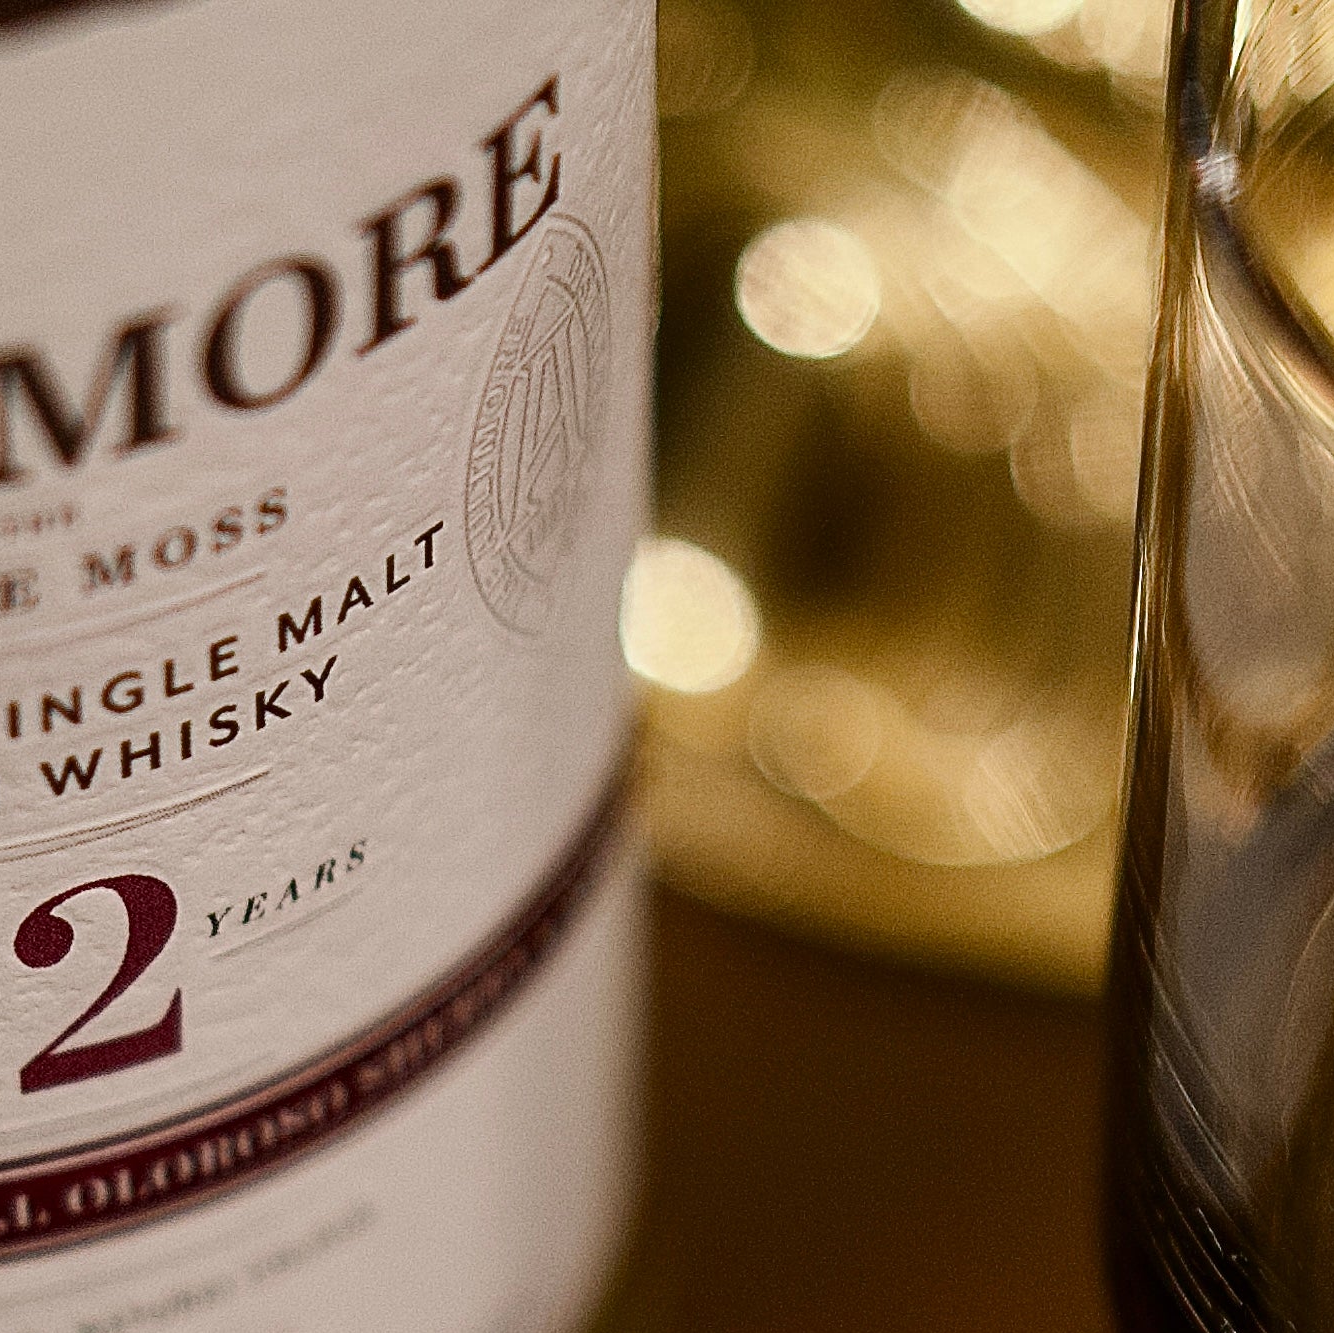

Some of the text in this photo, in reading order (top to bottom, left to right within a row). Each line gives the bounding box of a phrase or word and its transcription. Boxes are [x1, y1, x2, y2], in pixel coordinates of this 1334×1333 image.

[79, 486, 288, 594] MOSS
[276, 520, 446, 653] MALT
[40, 655, 339, 796] WHISKY
[206, 838, 369, 938] YEARS
